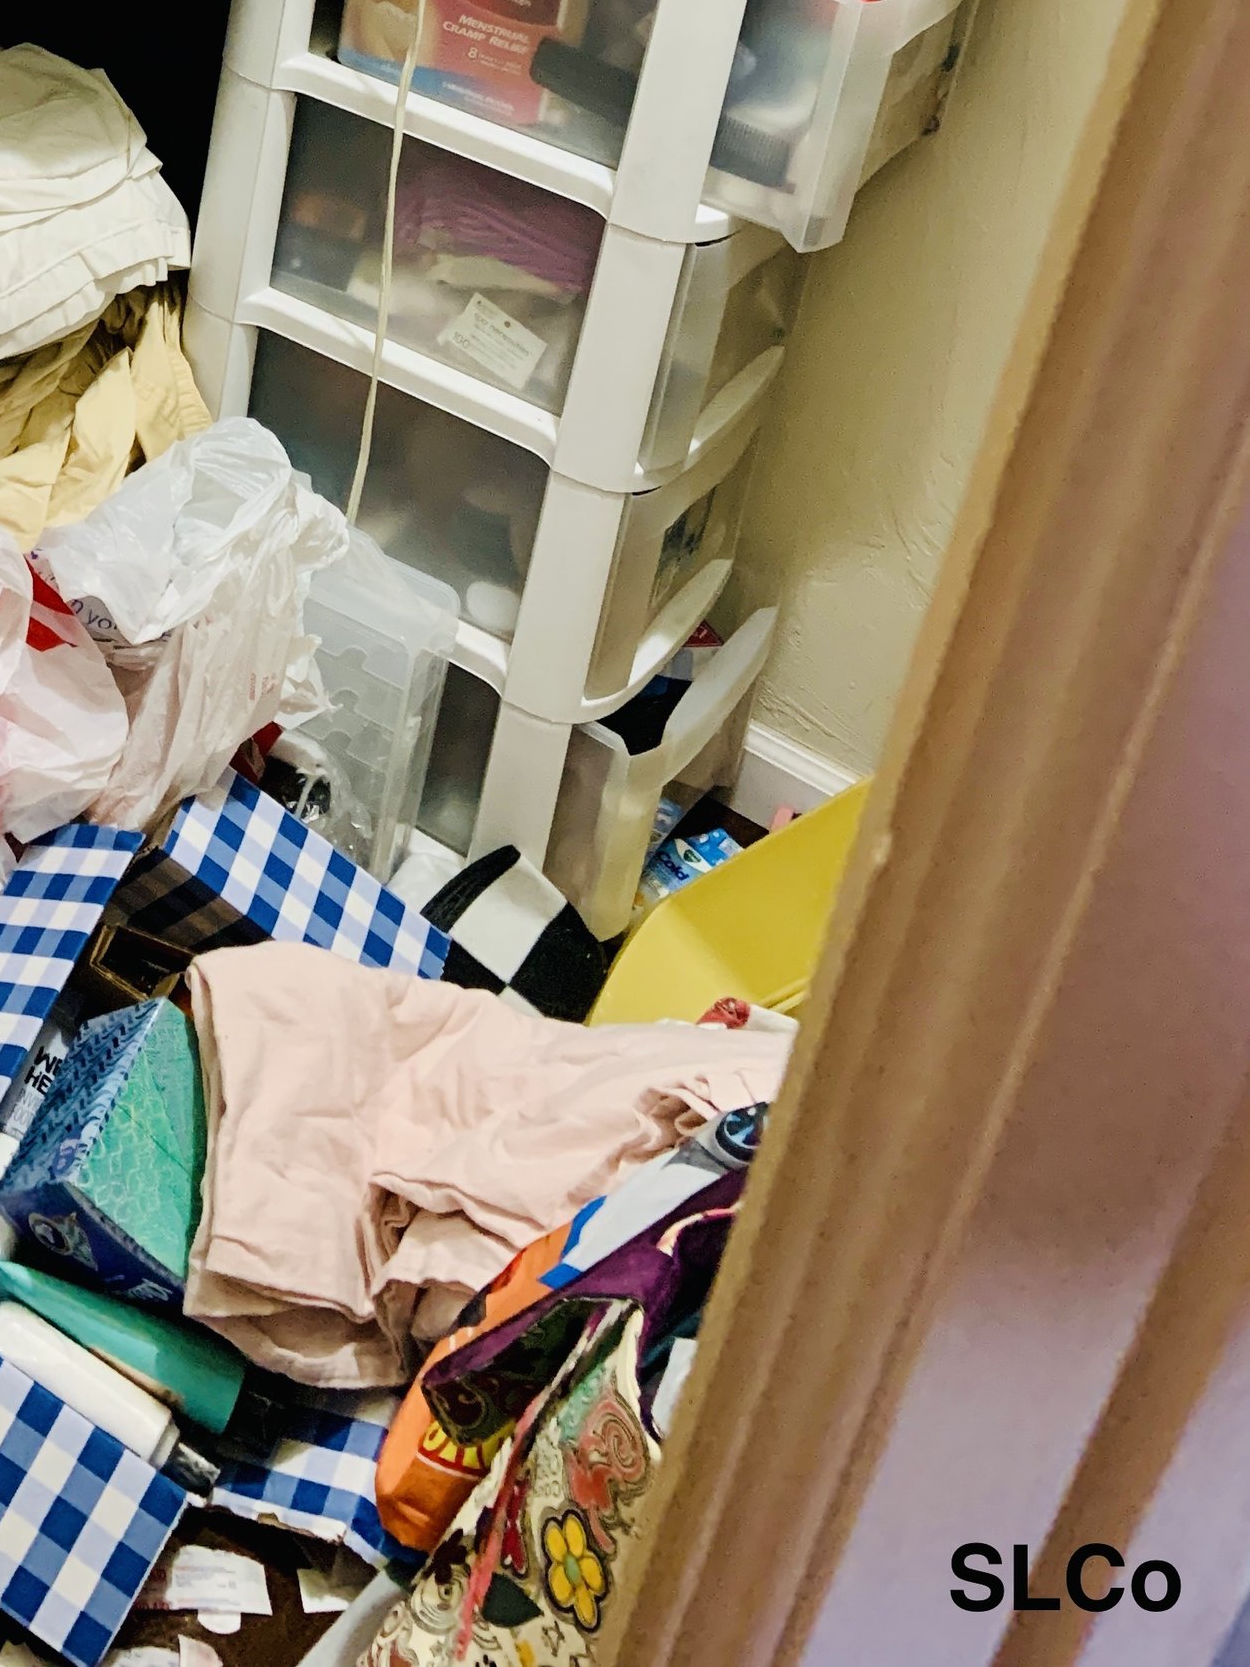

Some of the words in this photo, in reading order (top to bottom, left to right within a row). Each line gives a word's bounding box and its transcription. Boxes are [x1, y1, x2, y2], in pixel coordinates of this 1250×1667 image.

[442, 20, 486, 41] CRAMP
[488, 37, 530, 55] RELIEF
[457, 14, 530, 41] MENSTRUAL
[467, 46, 478, 60] 8
